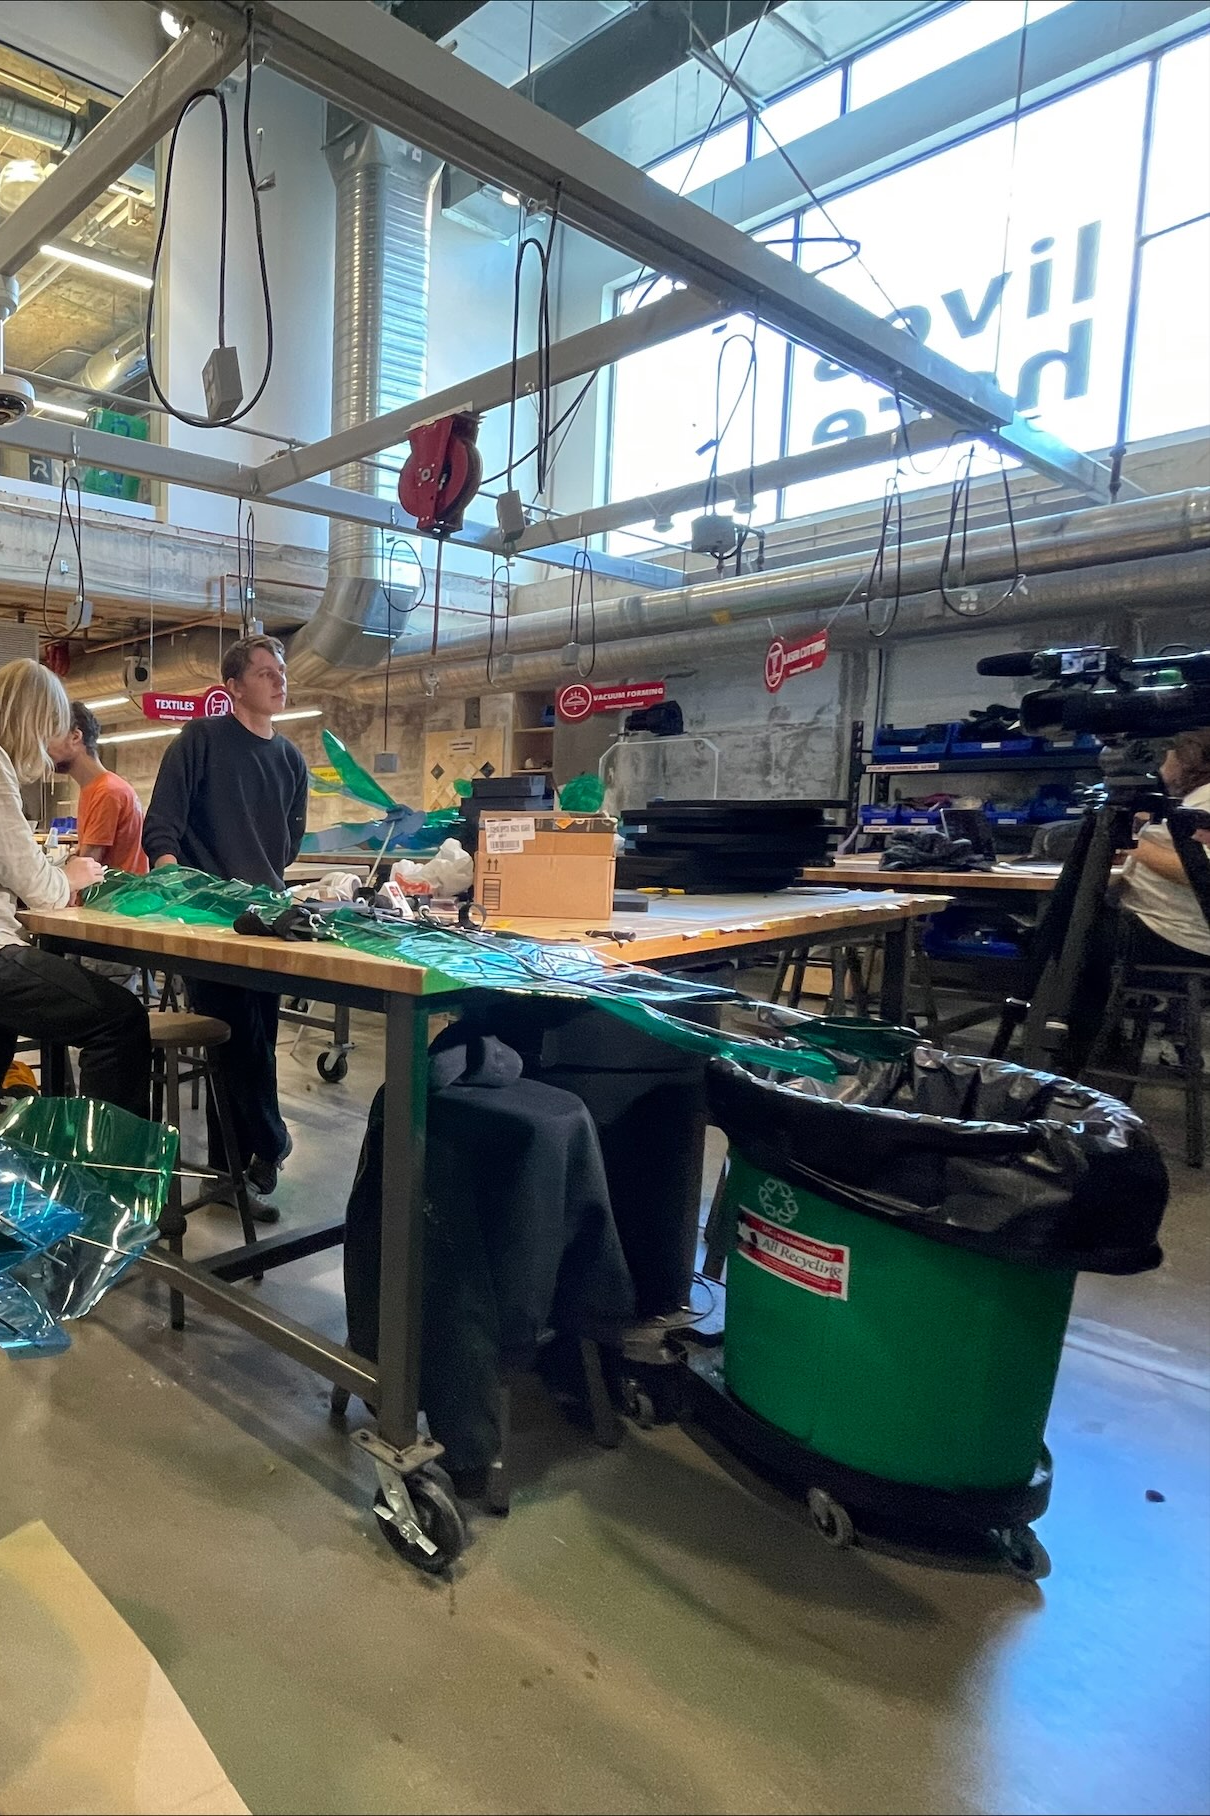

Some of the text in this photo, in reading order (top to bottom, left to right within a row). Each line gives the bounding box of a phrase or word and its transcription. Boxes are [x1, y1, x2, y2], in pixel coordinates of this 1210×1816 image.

[593, 687, 663, 702] VACUUM FORMING
[155, 699, 194, 711] TEXTILES
[762, 1239, 778, 1253] All
[780, 1245, 843, 1279] Recycling
